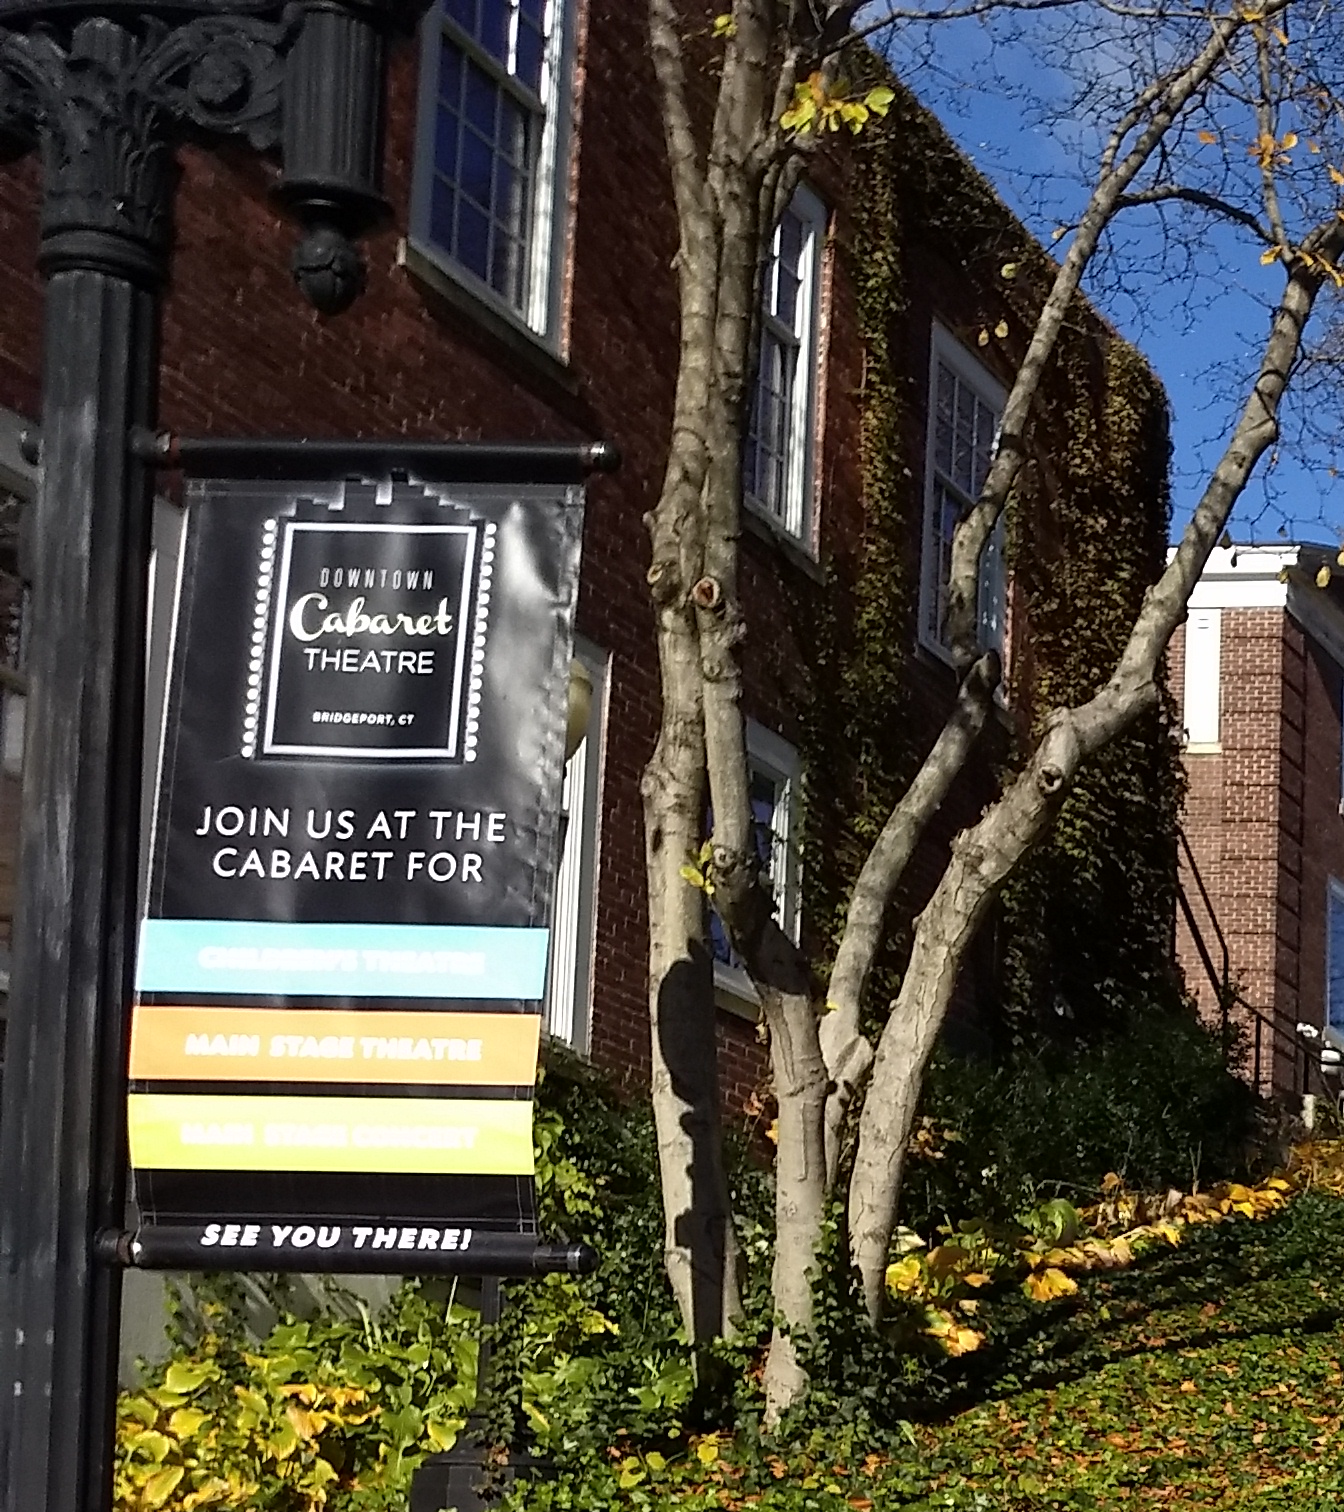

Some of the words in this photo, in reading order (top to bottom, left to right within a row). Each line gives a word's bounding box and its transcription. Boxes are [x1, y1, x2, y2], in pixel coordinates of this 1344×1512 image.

[319, 567, 434, 590] DOWNTOWN
[289, 592, 453, 642] Cabaret
[303, 648, 435, 674] THEATRE
[312, 711, 396, 727] BRIDGEPORT,
[398, 713, 415, 726] CT
[196, 806, 290, 837] JOIN
[307, 810, 355, 840] US
[366, 810, 416, 840] AT
[429, 811, 506, 842] THE
[212, 848, 394, 881] CABARET
[407, 852, 483, 882] FOR
[362, 950, 486, 975] THEATRE
[185, 1033, 260, 1056] MAIN
[269, 1035, 355, 1059] STAGE
[360, 1037, 483, 1061] THEATRE
[180, 1122, 255, 1145] MAIN
[200, 1224, 261, 1247] SEE
[271, 1225, 341, 1248] YOU
[352, 1226, 472, 1250] THERE!
